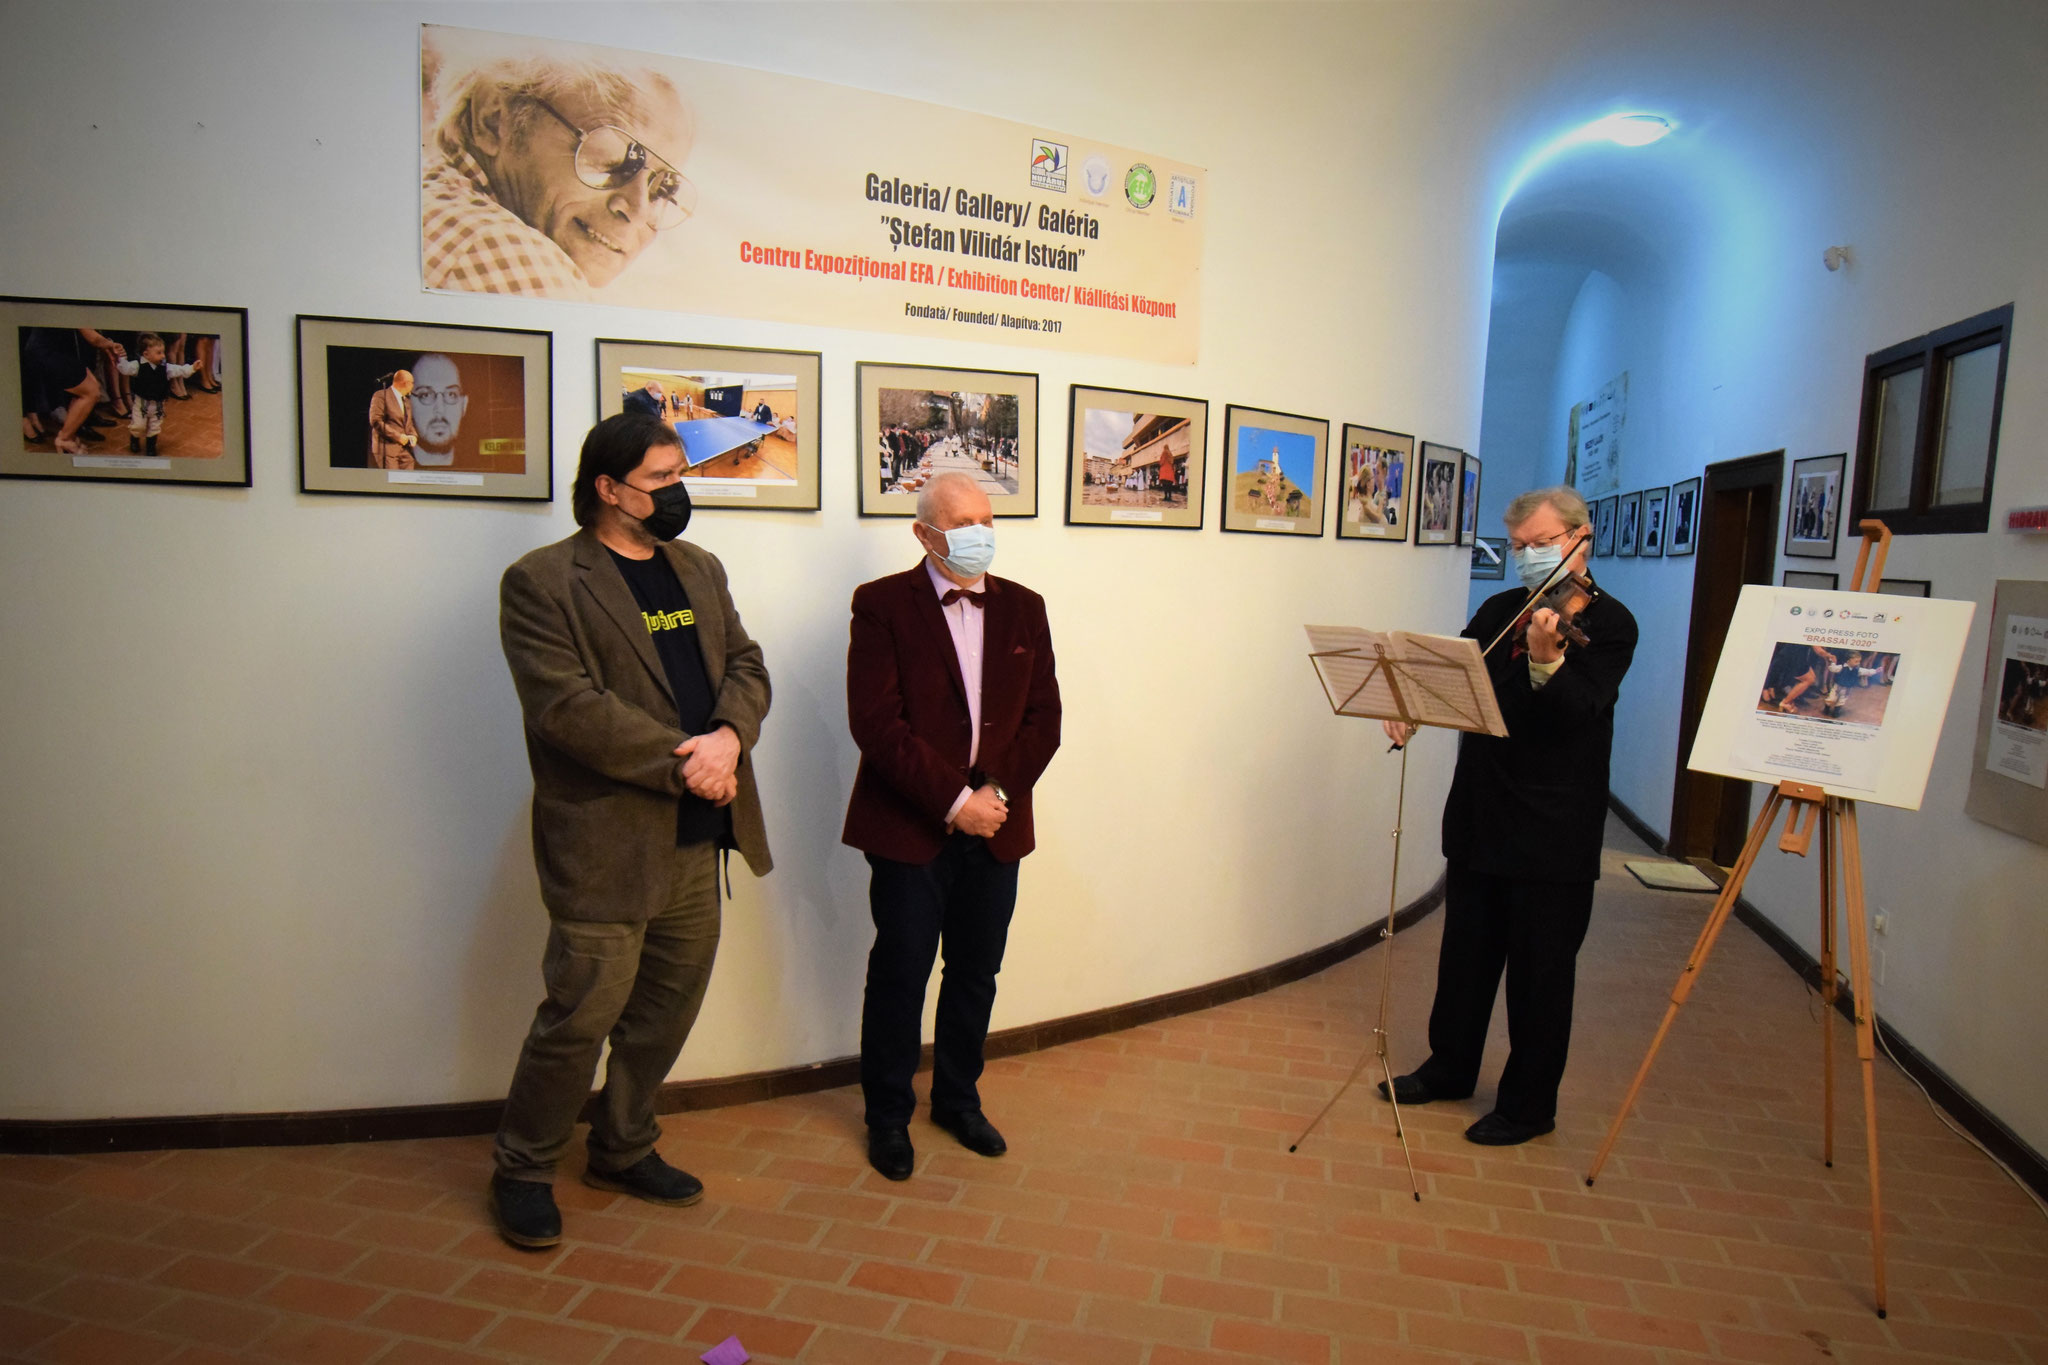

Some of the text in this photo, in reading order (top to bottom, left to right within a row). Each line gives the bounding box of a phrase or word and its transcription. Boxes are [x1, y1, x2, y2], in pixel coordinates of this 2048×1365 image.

[865, 172, 1100, 240] Galeria/ Gallery/ Galéria
[960, 228, 1022, 263] Vilidár
[740, 241, 1177, 319] Centru Expozițional EFA / Exhibition Center/ Kiállítási Központ
[904, 302, 1062, 334] Fondată/ Founded/ Alapítva: 2017
[1804, 626, 1879, 640] EXPO PRESS FOTO
